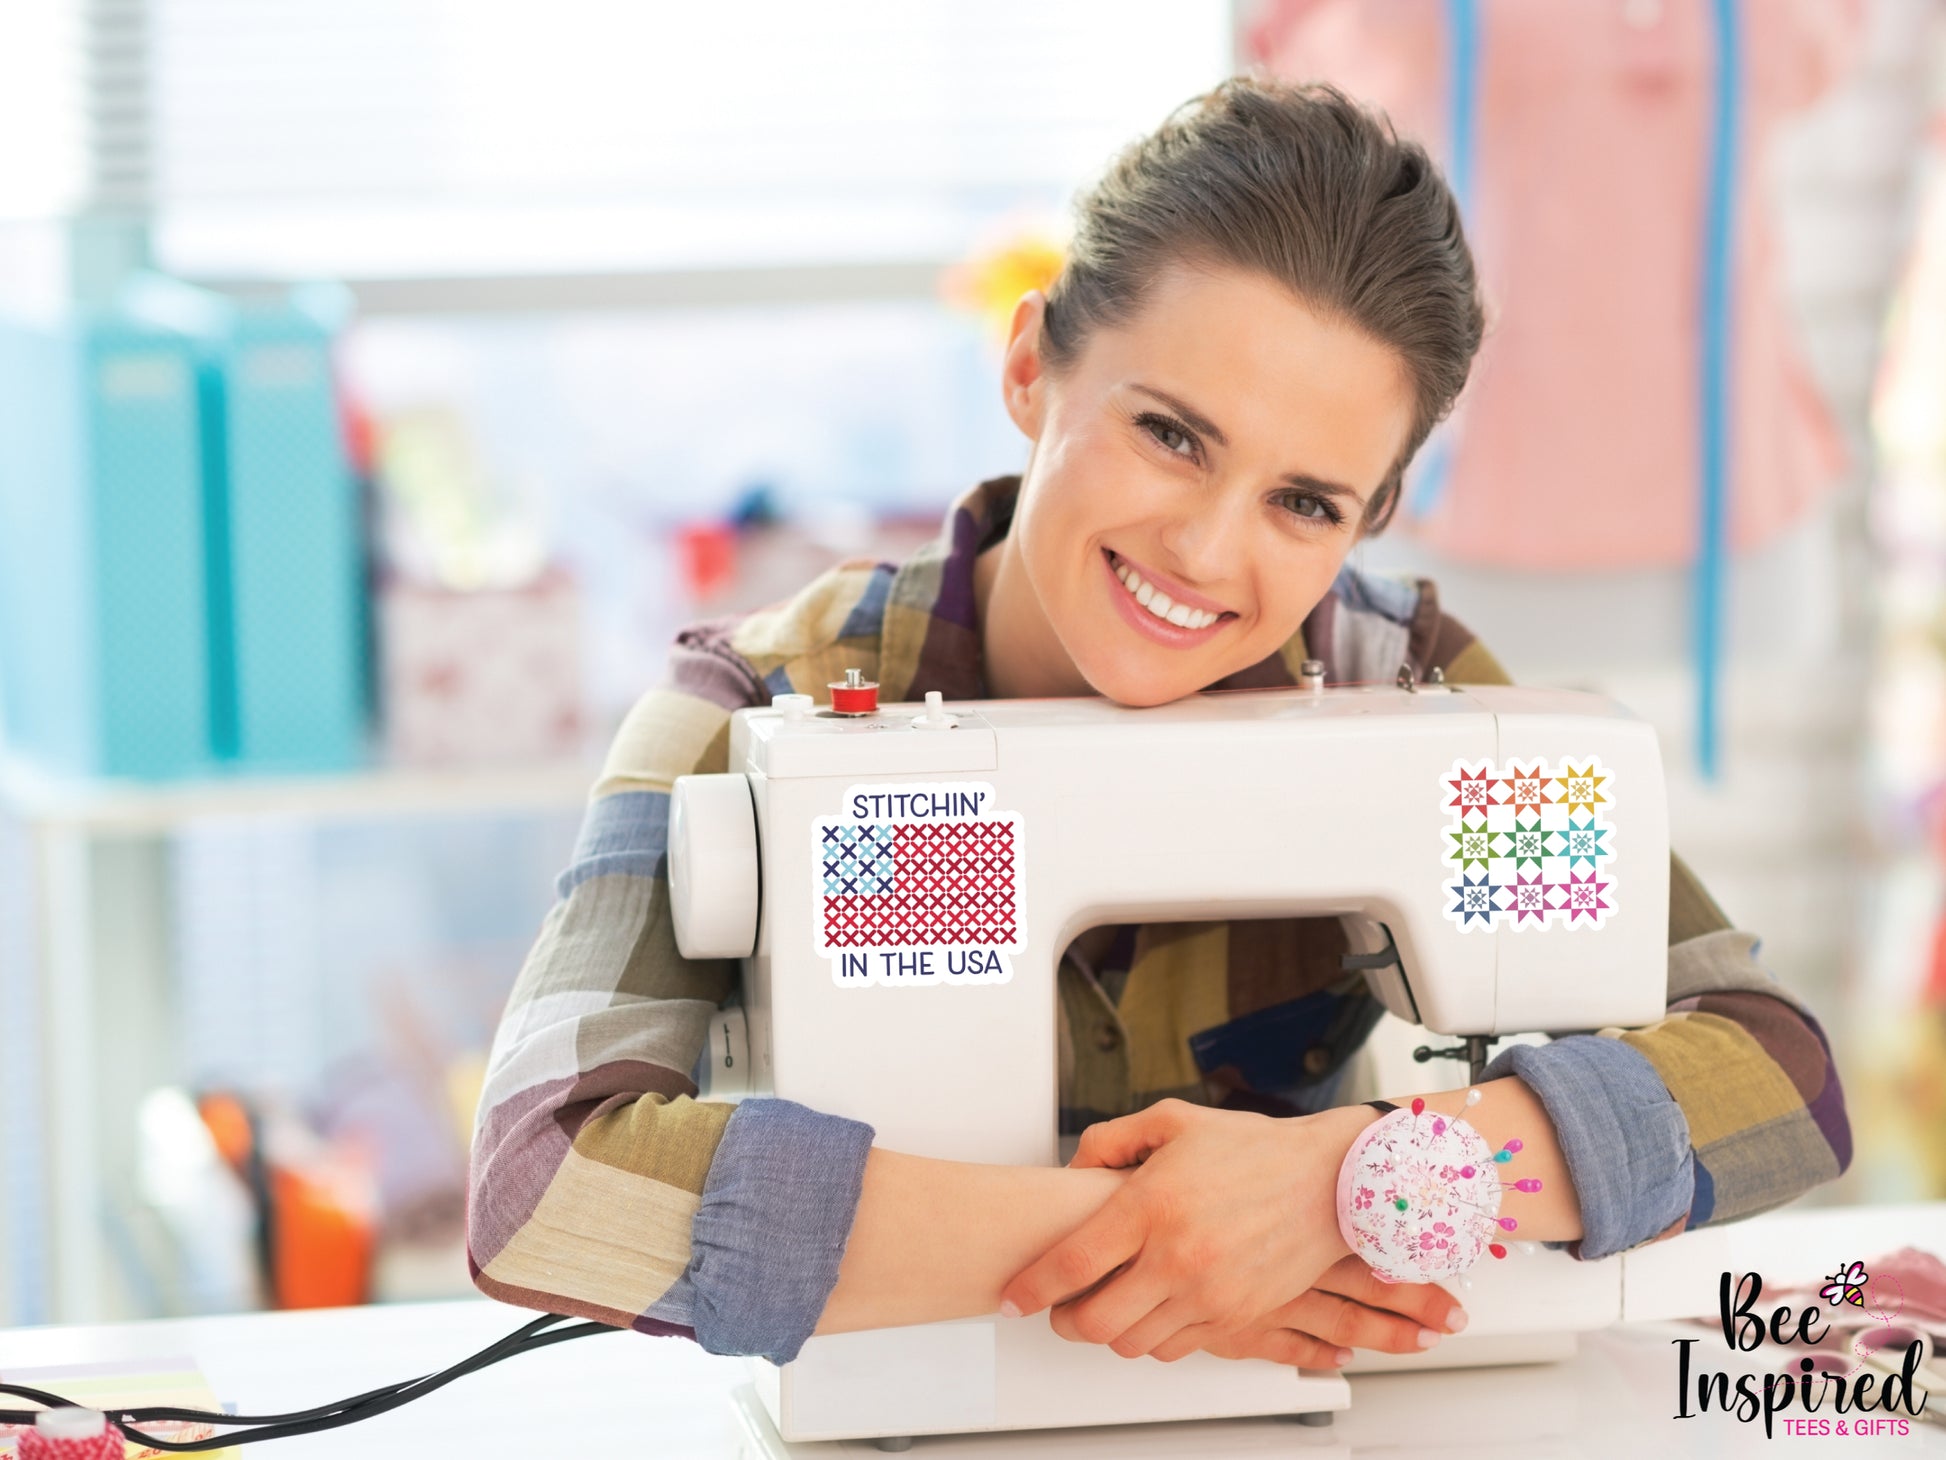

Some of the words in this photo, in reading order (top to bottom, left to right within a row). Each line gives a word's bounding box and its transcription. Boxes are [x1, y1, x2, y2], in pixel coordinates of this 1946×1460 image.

[853, 792, 985, 819] STITCHIN’
[842, 953, 867, 977] IN
[880, 952, 934, 976] THE
[948, 950, 1002, 974] USA
